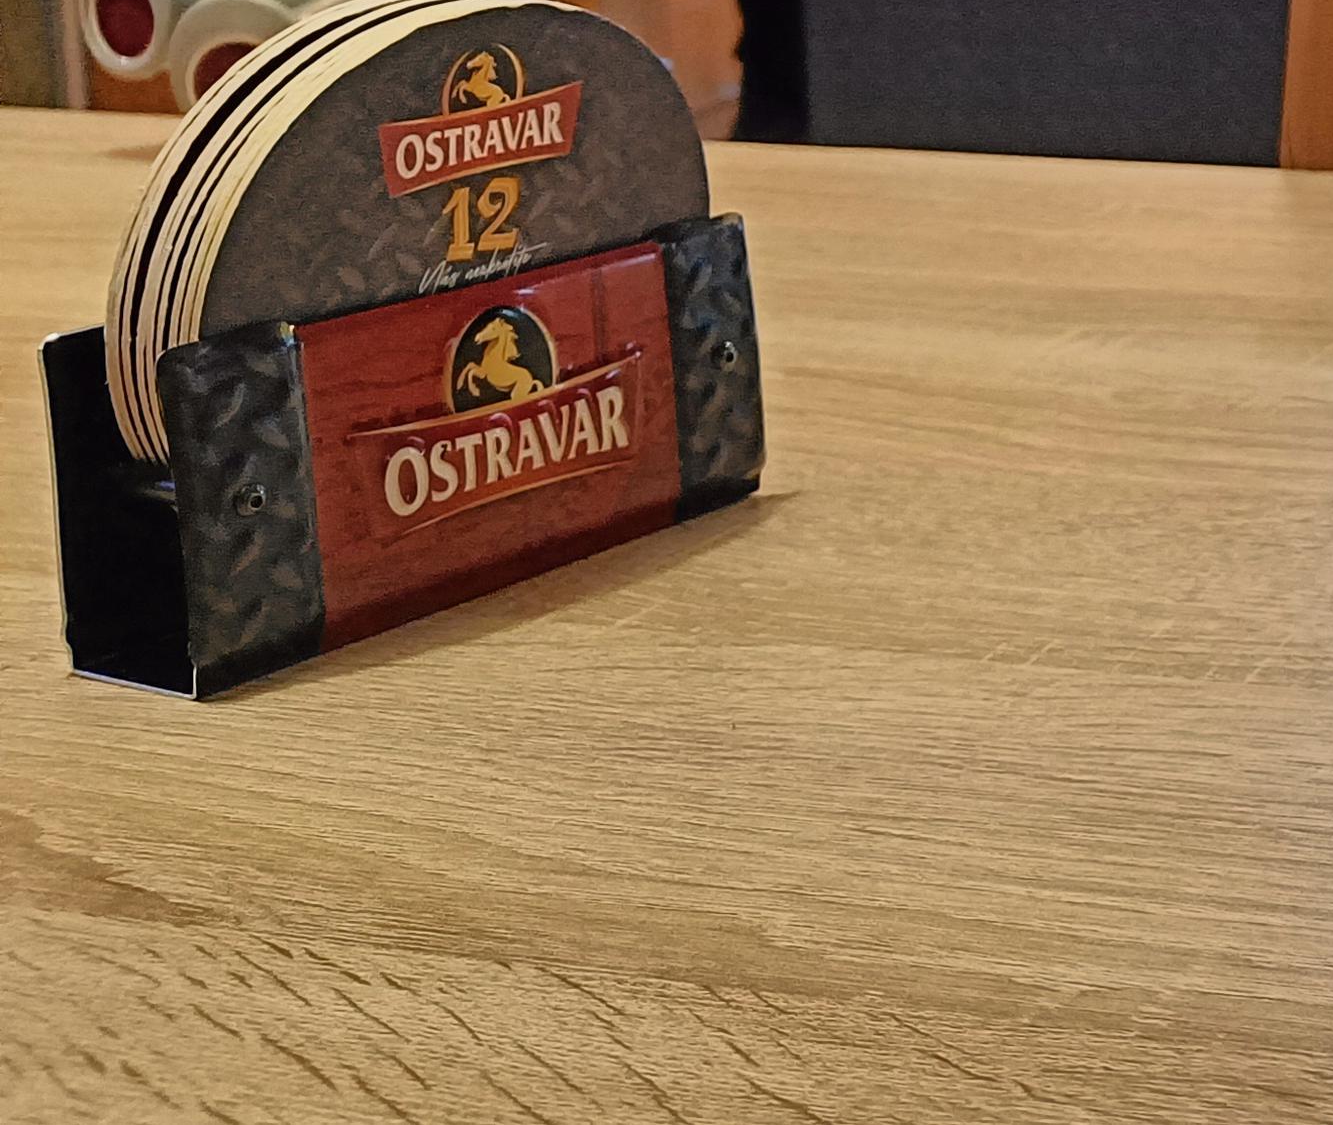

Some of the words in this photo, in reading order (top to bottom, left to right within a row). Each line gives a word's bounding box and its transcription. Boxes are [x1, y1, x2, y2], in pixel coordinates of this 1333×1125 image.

[395, 102, 565, 180] OSTRAVAR
[442, 176, 520, 262] 12
[384, 385, 629, 517] OSTRAVAR
